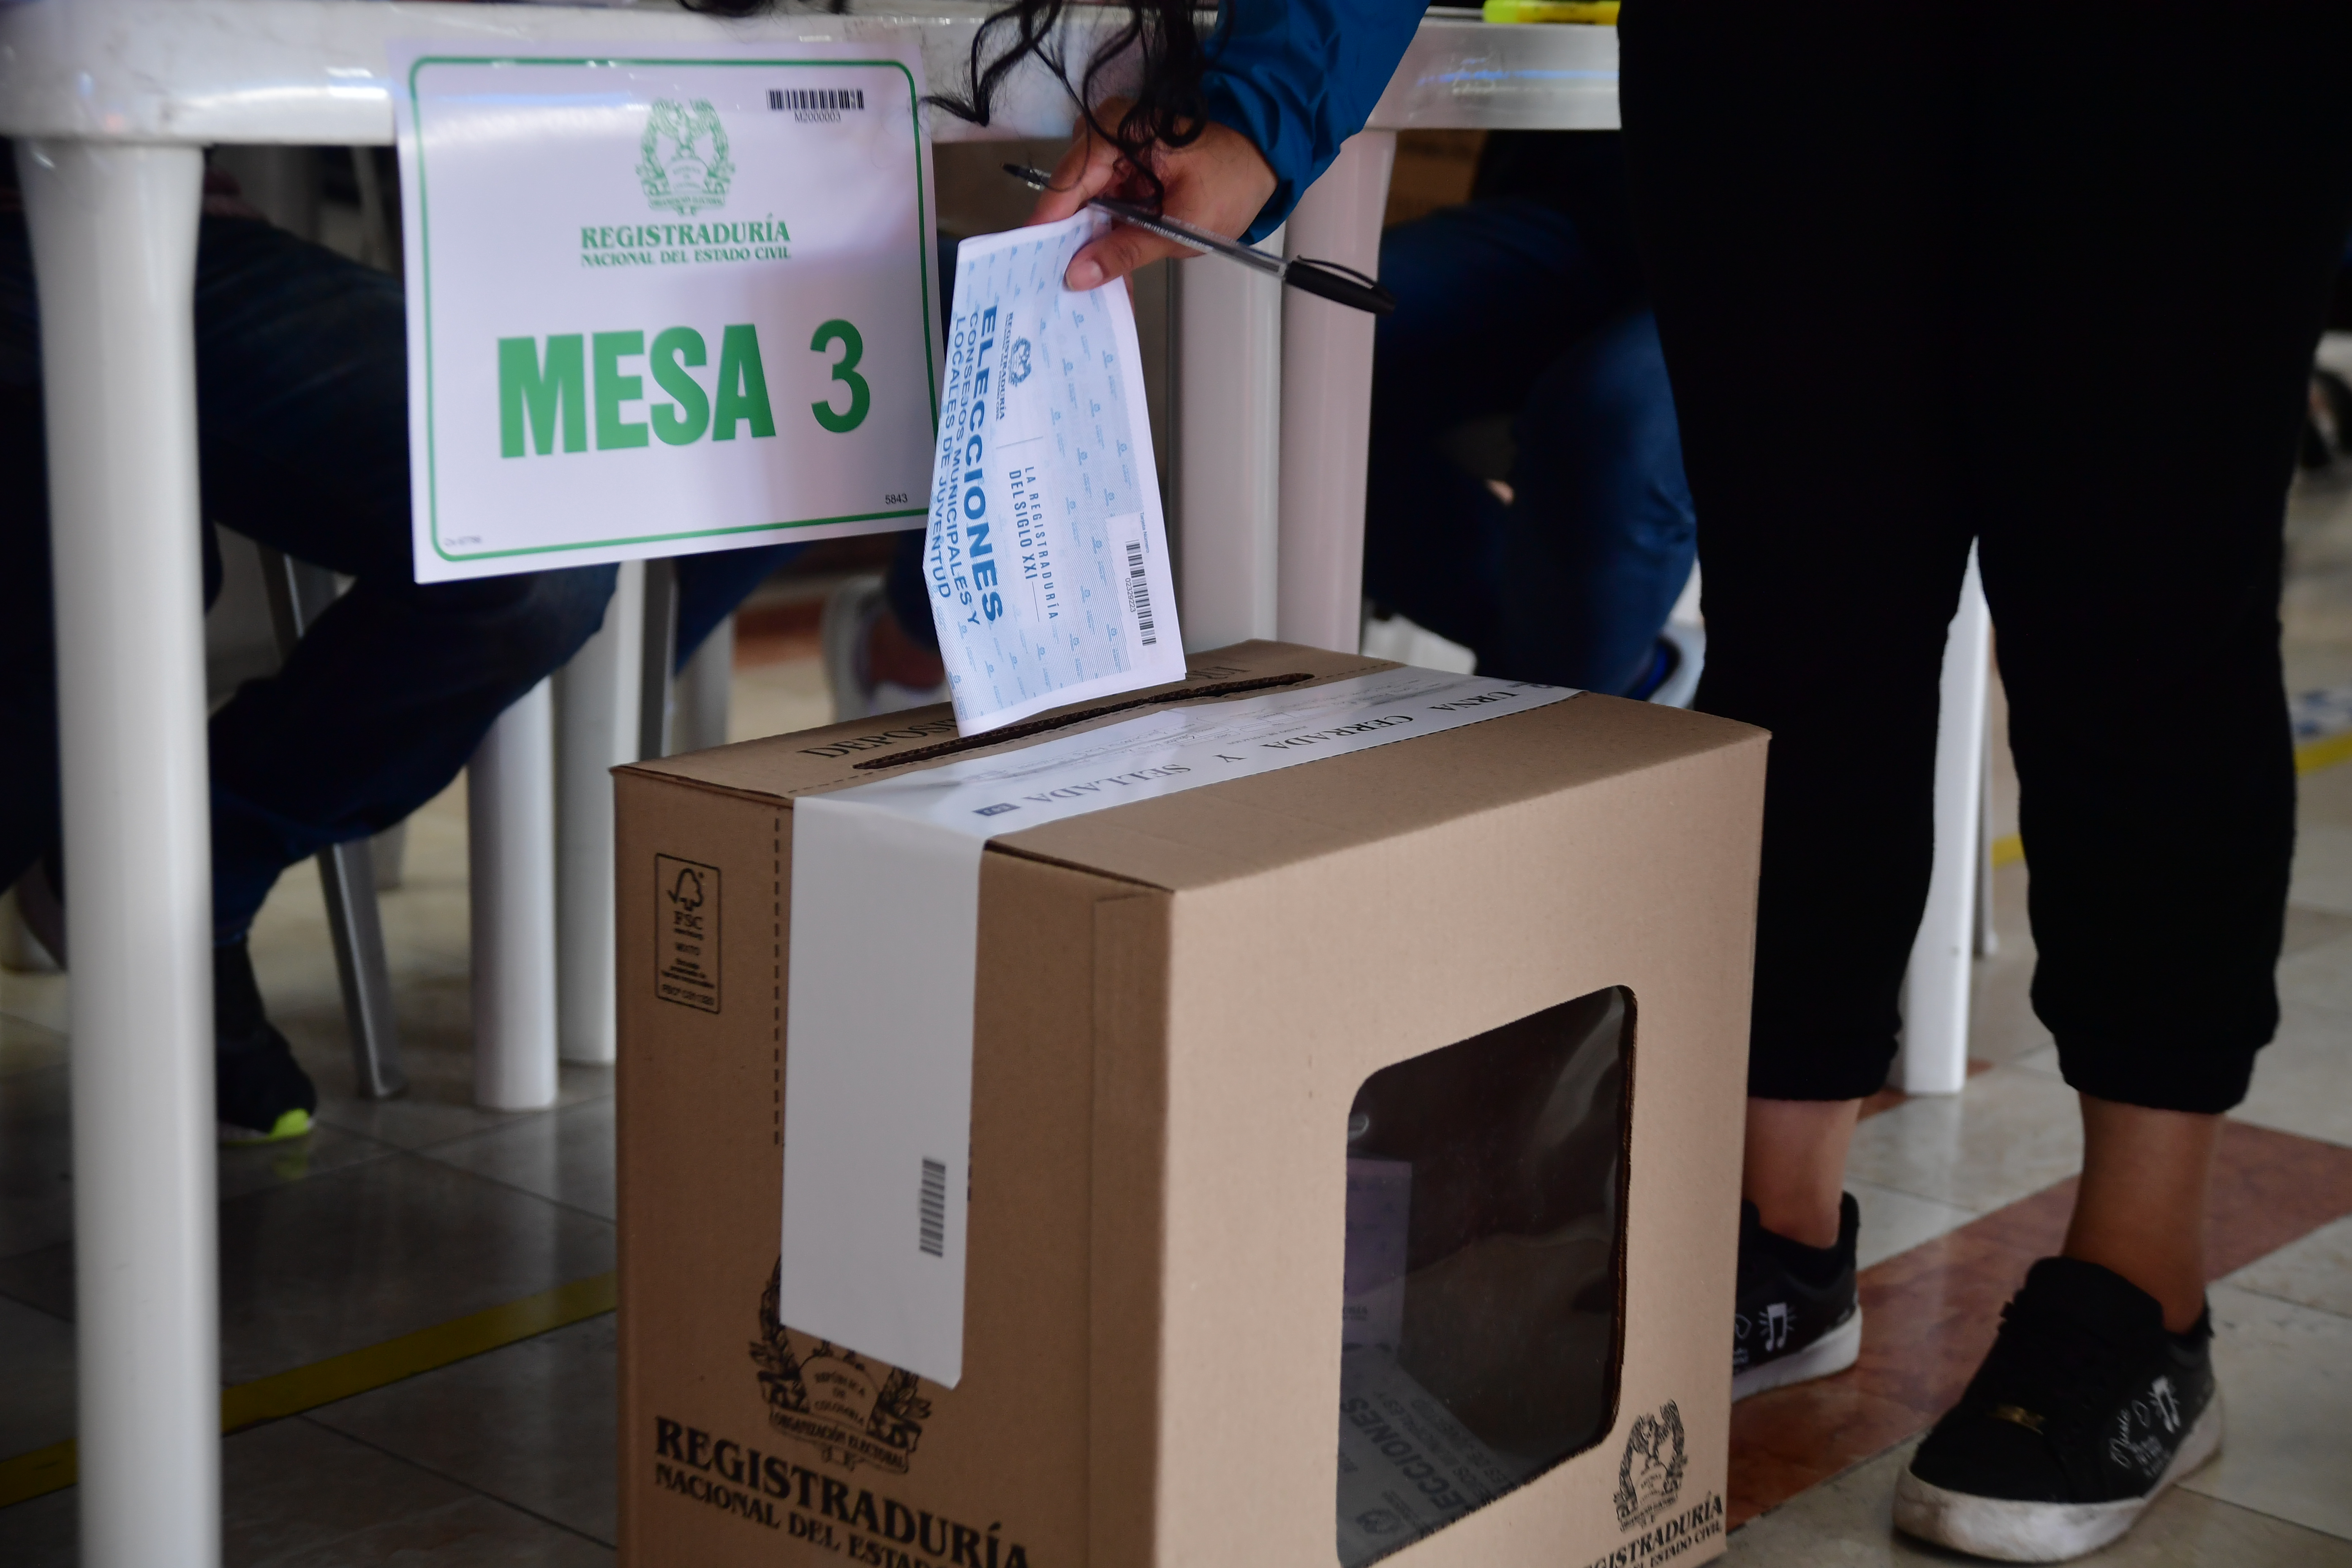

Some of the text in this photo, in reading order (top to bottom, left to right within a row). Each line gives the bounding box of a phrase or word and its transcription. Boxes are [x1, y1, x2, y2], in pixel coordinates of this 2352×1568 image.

[580, 212, 791, 249] REGISTRADURÍA
[581, 246, 791, 267] NACIONAL DEL ESTADO CIVIL
[999, 311, 1013, 420] REGISTRADURÍA
[497, 318, 870, 459] MESA 3
[931, 316, 966, 598] LOCALES DE JUVENTUD
[946, 312, 980, 625] CONSEJOS MUNICIPALES Y
[964, 305, 1003, 621] ELECCIONES
[885, 493, 908, 504] 5843
[1025, 466, 1059, 619] LA REGISTRADURÍA
[1022, 553, 1038, 579] XXI
[1125, 577, 1136, 613] 02329223
[1426, 691, 1520, 711] URNA
[797, 718, 957, 758] DEPOSI
[1259, 715, 1414, 749] CERRADA
[1213, 754, 1248, 763] Y
[1022, 764, 1192, 803] SELLADA
[656, 1416, 1029, 1568] REGISTRADURÍA
[656, 1462, 948, 1568] NACIONAL DEL ESTA
[1583, 1490, 1723, 1568] GISTRADURÍA
